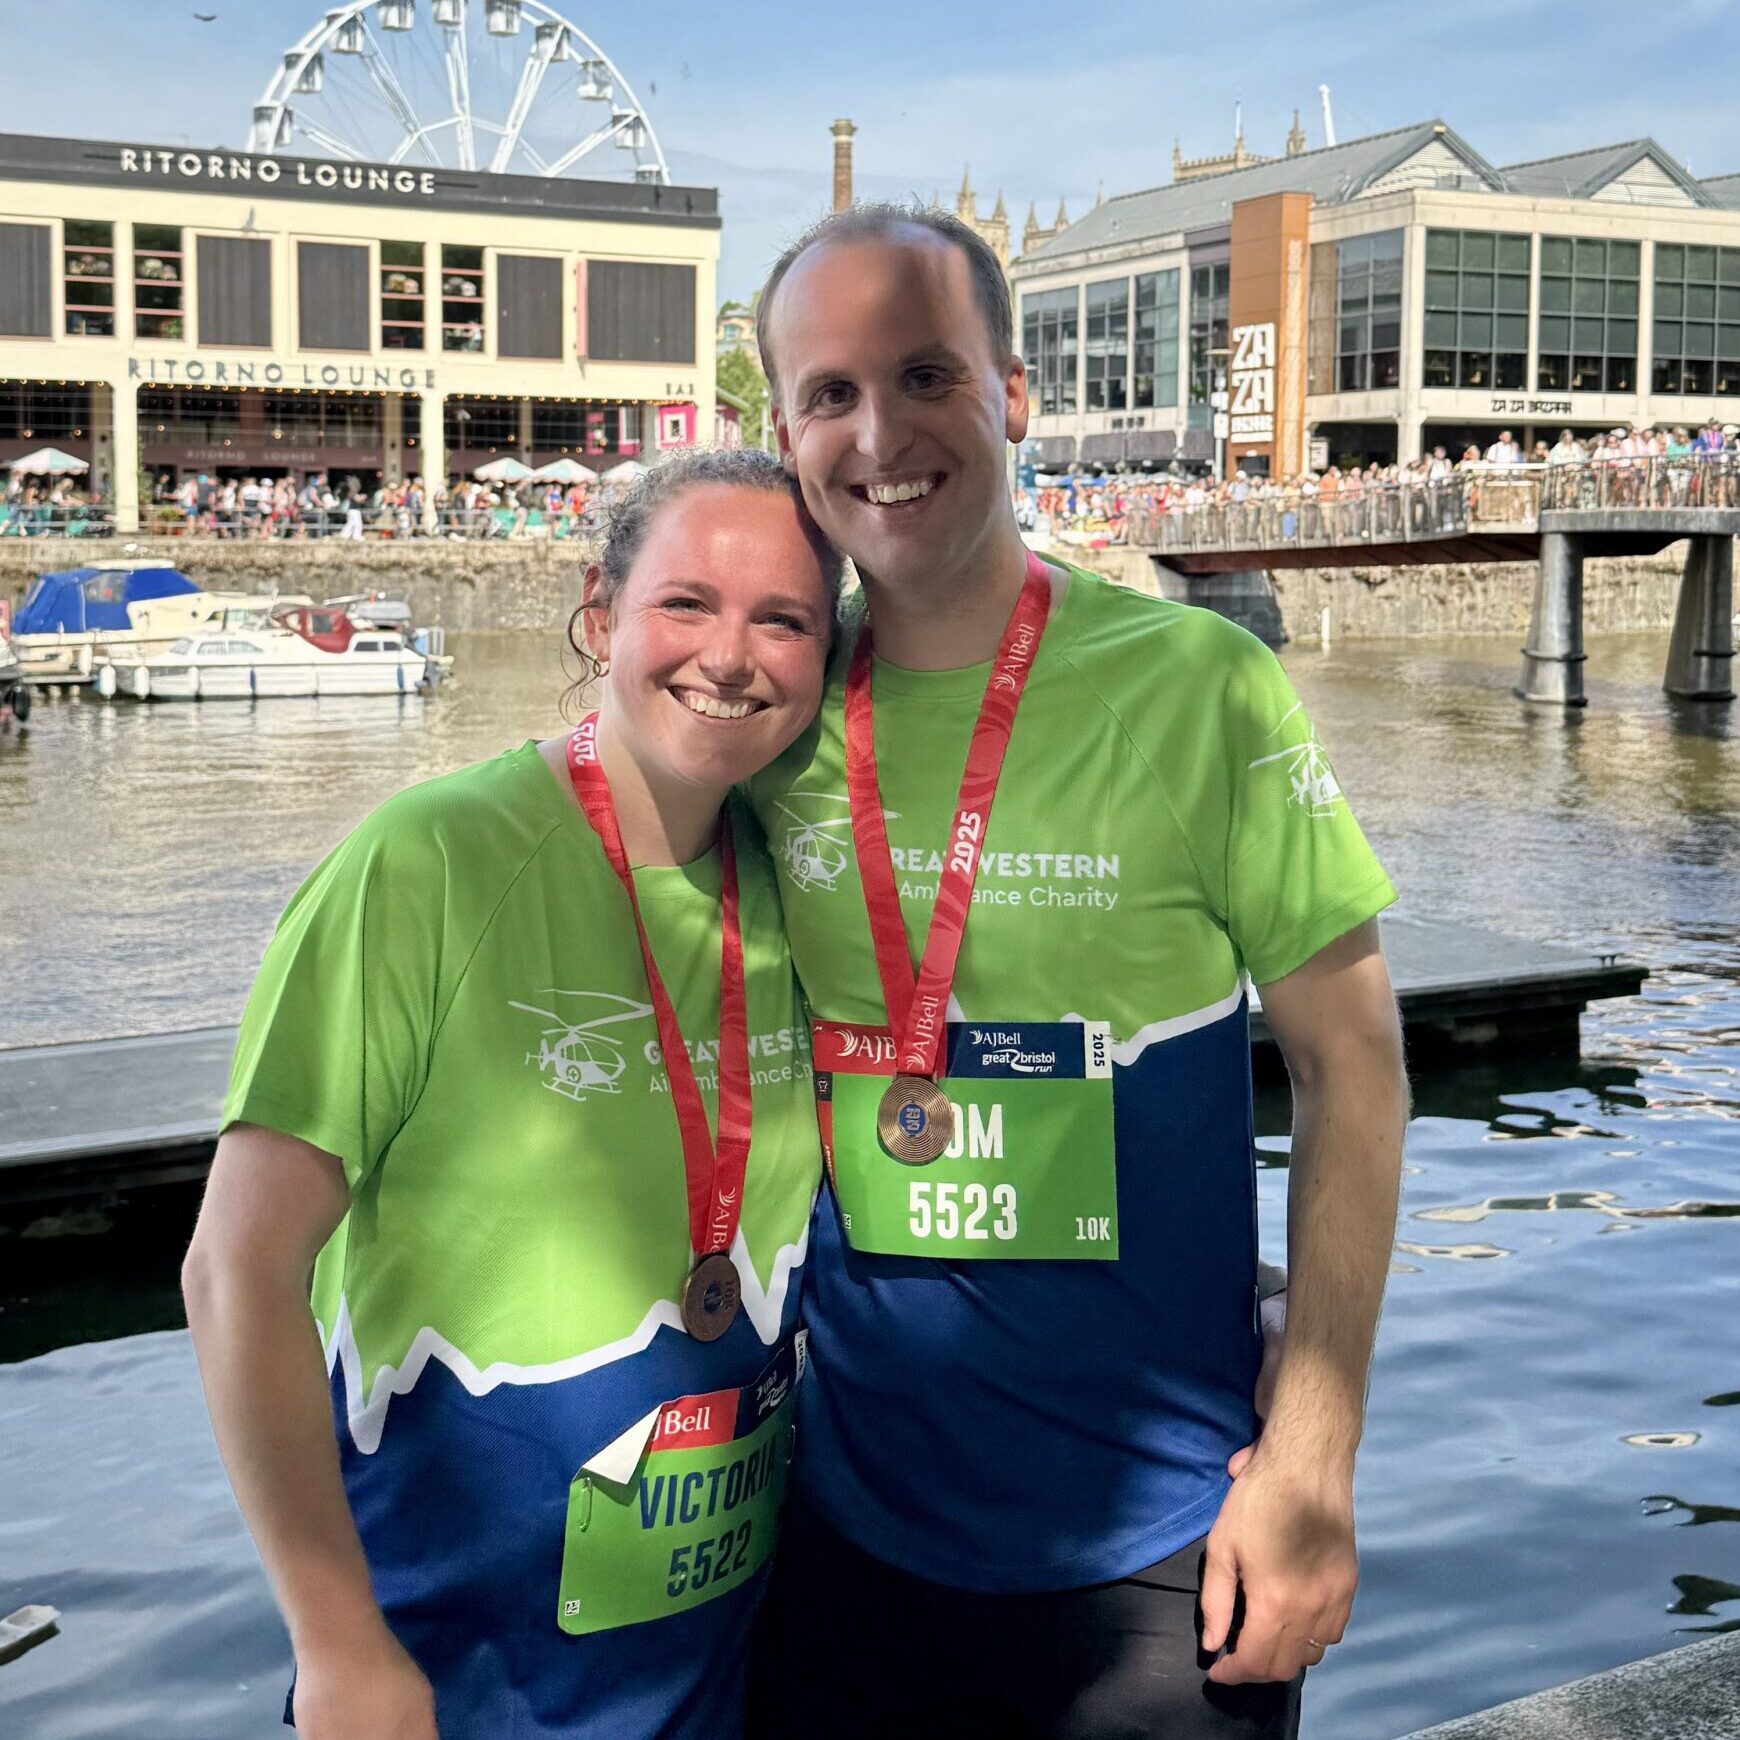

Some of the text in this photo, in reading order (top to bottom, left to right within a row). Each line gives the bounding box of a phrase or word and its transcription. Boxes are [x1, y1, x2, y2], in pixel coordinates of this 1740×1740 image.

[120, 149, 435, 194] RITORNO LOUNGE
[1231, 322, 1275, 370] ZA
[128, 357, 436, 389] RITORNO LOUNGE
[1231, 368, 1274, 414] ZA
[950, 810, 982, 875] 2025
[1029, 884, 1119, 911] Charity
[912, 995, 939, 1056] AJBell
[982, 1032, 1021, 1047] AJBell
[982, 1051, 1056, 1065] great bristol
[1092, 1033, 1106, 1067] 2025
[909, 1181, 1018, 1240] 5523
[1075, 1217, 1111, 1241] 10K
[667, 1520, 753, 1598] 5522
